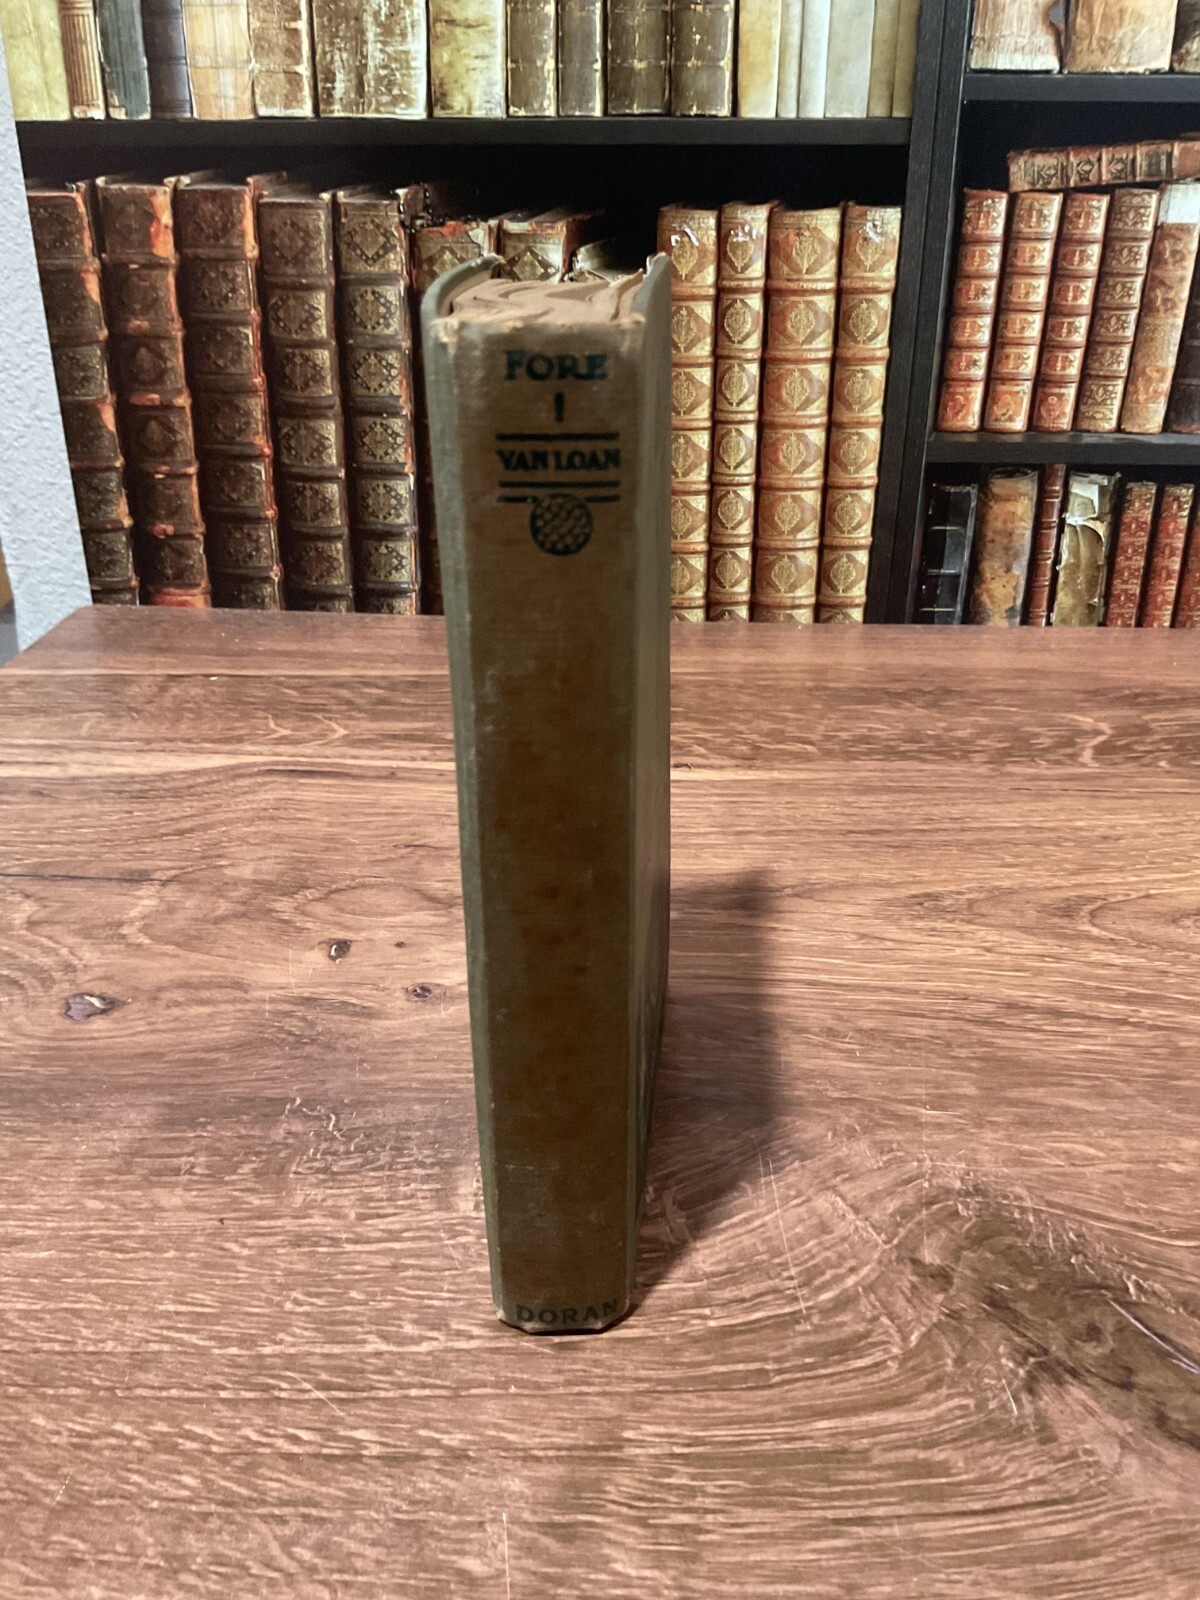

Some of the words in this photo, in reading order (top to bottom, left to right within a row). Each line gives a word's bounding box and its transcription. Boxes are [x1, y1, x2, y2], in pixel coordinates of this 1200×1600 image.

[504, 350, 608, 381] FORE
[496, 449, 548, 471] VAN
[552, 448, 621, 471] LOAN
[516, 1298, 618, 1325] DORAN
